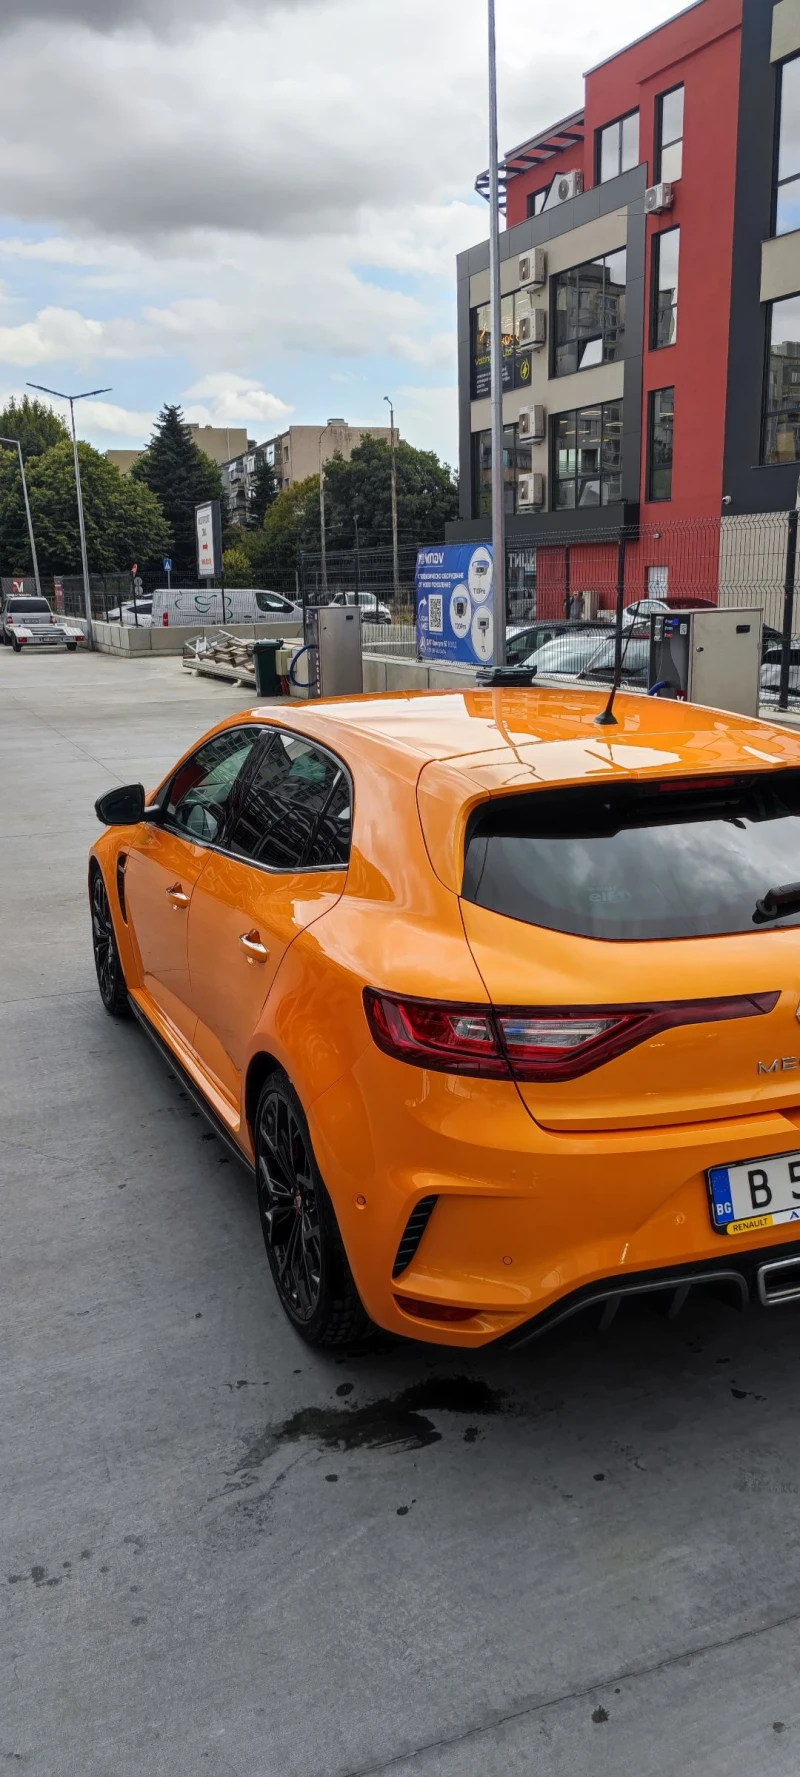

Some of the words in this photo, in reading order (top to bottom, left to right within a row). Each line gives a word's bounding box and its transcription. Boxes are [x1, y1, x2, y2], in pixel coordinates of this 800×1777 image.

[758, 1056, 800, 1076] ME
[747, 1169, 772, 1210] B
[716, 1202, 732, 1216] BG
[732, 1217, 769, 1232] RENAULT
